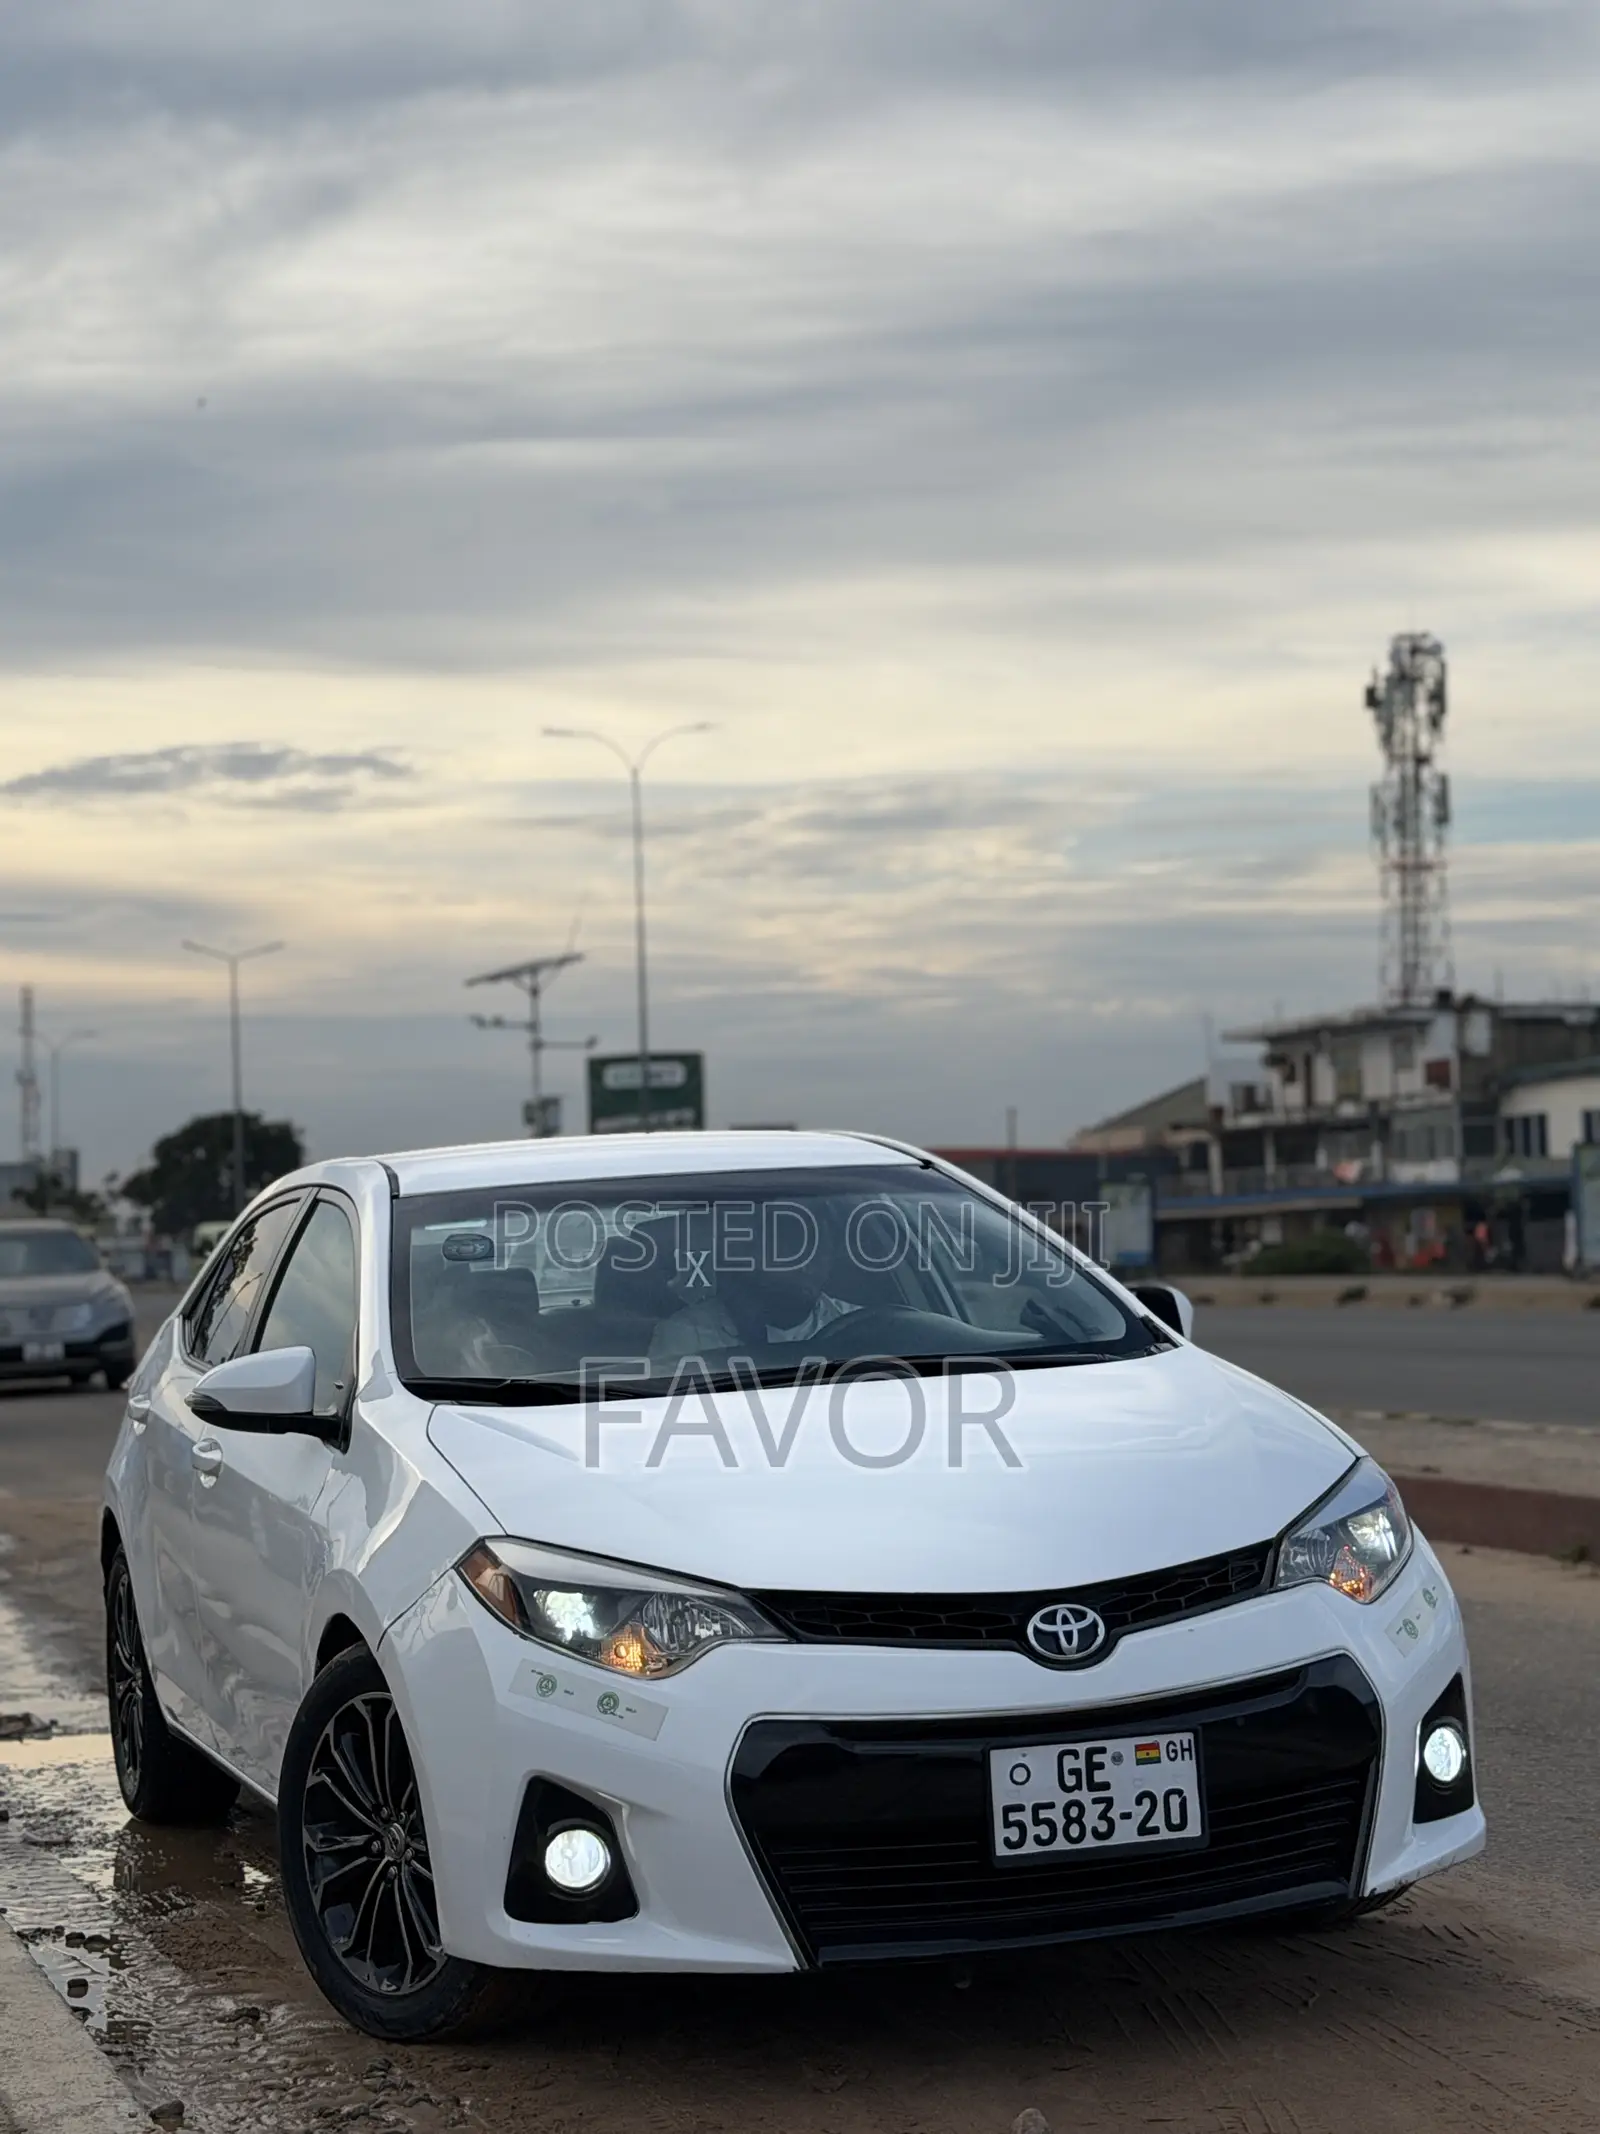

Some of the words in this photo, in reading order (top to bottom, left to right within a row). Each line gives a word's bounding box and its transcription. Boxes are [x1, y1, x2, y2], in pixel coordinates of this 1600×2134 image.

[1057, 1746, 1112, 1793] GE
[1166, 1738, 1193, 1762] GH
[1002, 1788, 1189, 1850] 5583-20
